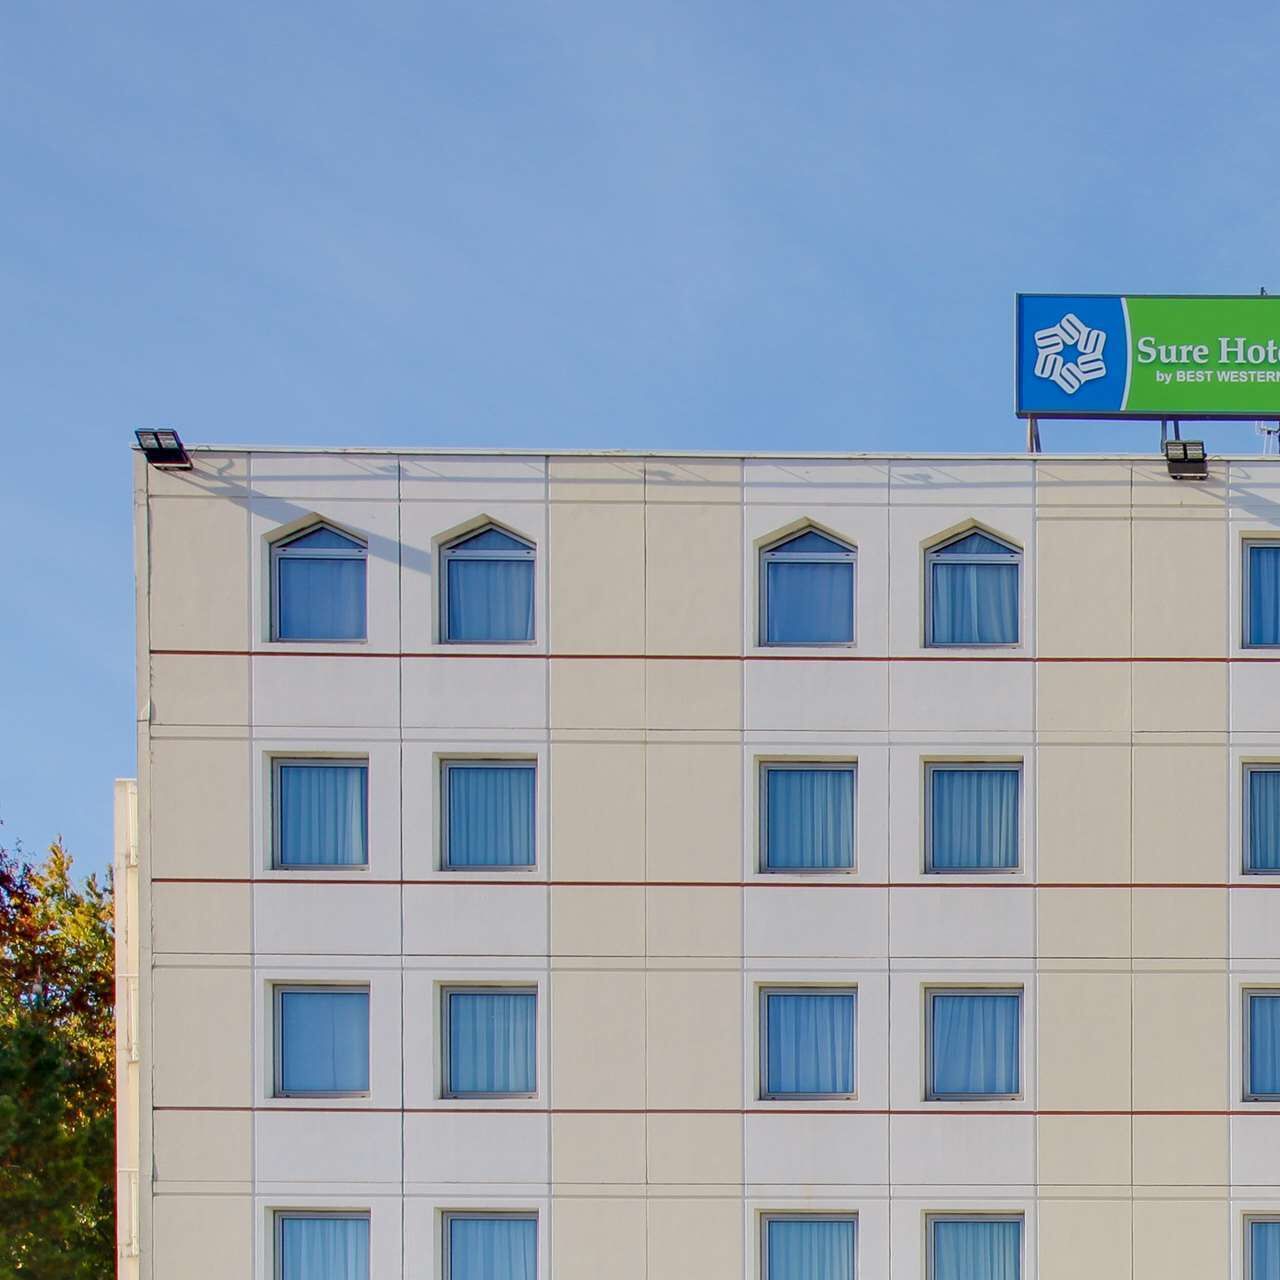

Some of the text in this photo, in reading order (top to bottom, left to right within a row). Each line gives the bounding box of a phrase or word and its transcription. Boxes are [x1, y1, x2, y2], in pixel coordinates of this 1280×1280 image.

[1137, 336, 1209, 364] Sure
[1156, 370, 1172, 384] by
[1176, 371, 1213, 382] BEST
